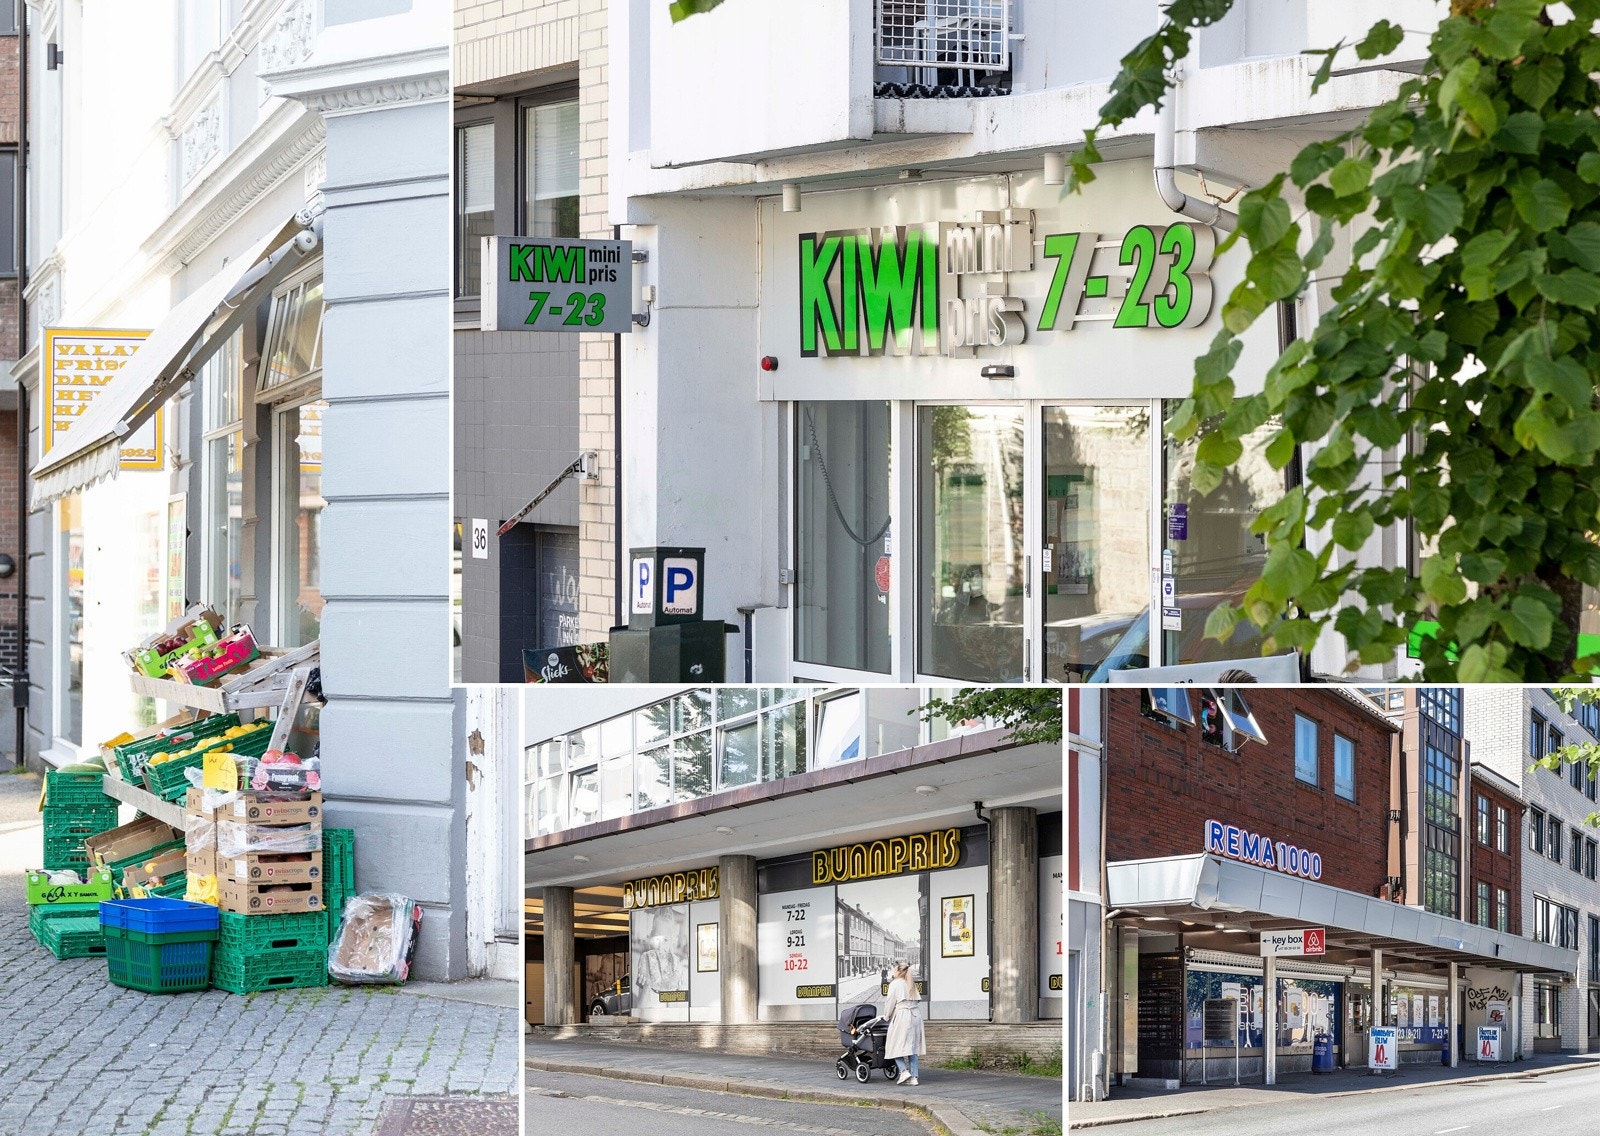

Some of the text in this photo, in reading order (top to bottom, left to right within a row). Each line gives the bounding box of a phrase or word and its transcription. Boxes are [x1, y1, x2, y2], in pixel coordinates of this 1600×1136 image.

[589, 246, 620, 263] mini
[946, 209, 1014, 275] mini
[509, 244, 586, 283] KIWI
[589, 265, 617, 285] pris
[1037, 221, 1196, 331] 7-23
[799, 222, 941, 358] KIWI
[524, 291, 606, 326] 7-23
[946, 283, 1008, 359] pris
[55, 389, 101, 401] HE
[474, 527, 486, 550] 36
[639, 562, 650, 598] P
[667, 567, 694, 603] P
[664, 606, 693, 614] Automat
[541, 663, 573, 684] Sticks
[812, 828, 961, 884] BUNNPRIS
[1206, 820, 1322, 880] REMA 1000
[622, 866, 720, 909] BUNNPRIS
[786, 909, 806, 921] 7-22
[787, 935, 806, 947] 9-21
[1272, 934, 1303, 946] key box
[784, 958, 808, 971] 10-22
